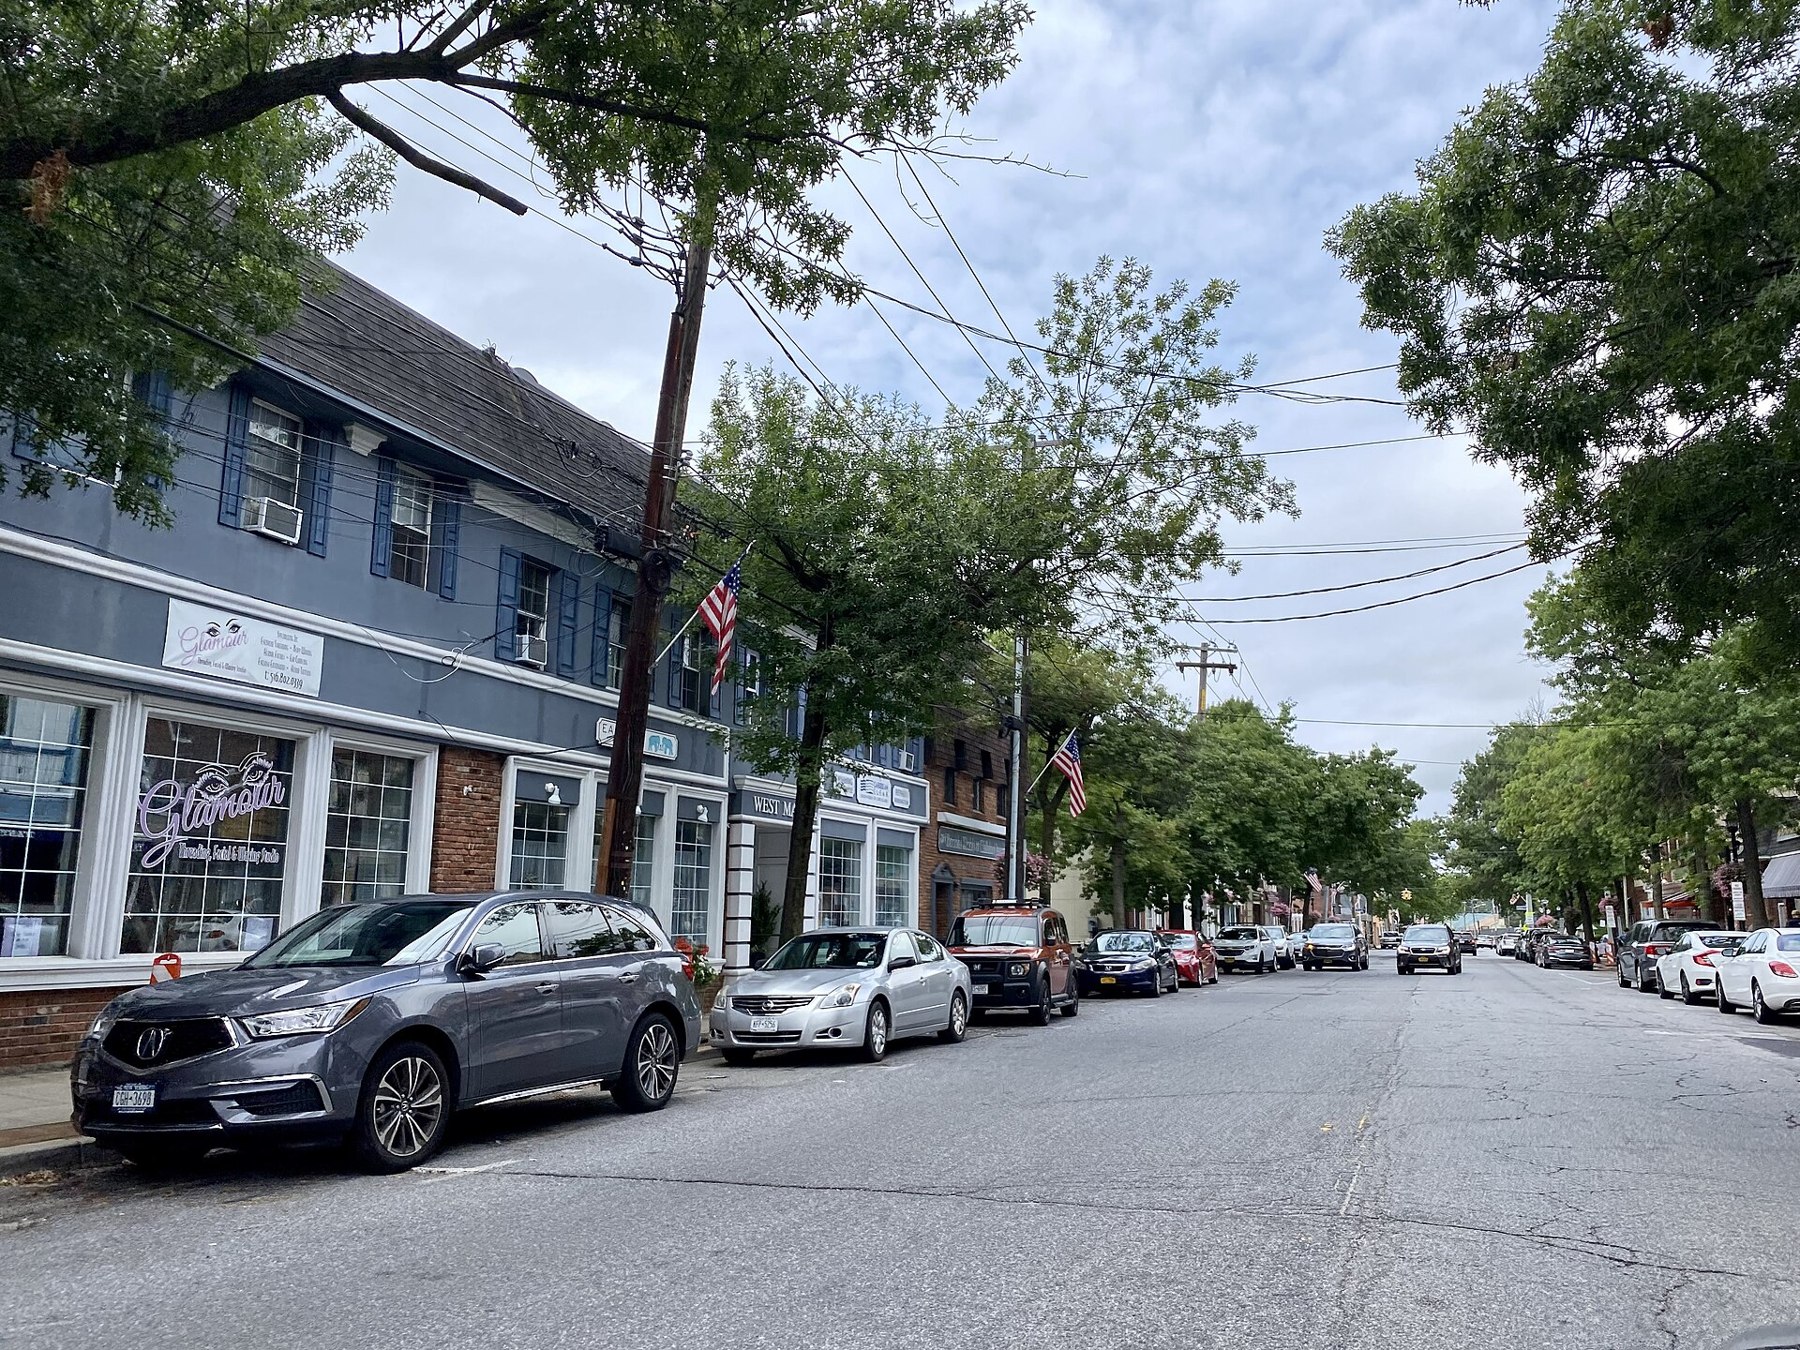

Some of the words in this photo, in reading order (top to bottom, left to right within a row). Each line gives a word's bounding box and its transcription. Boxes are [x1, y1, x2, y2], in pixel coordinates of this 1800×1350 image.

[178, 626, 249, 666] Glamour
[602, 723, 614, 734] EA
[753, 795, 780, 815] WEST
[136, 774, 286, 869] Glamour
